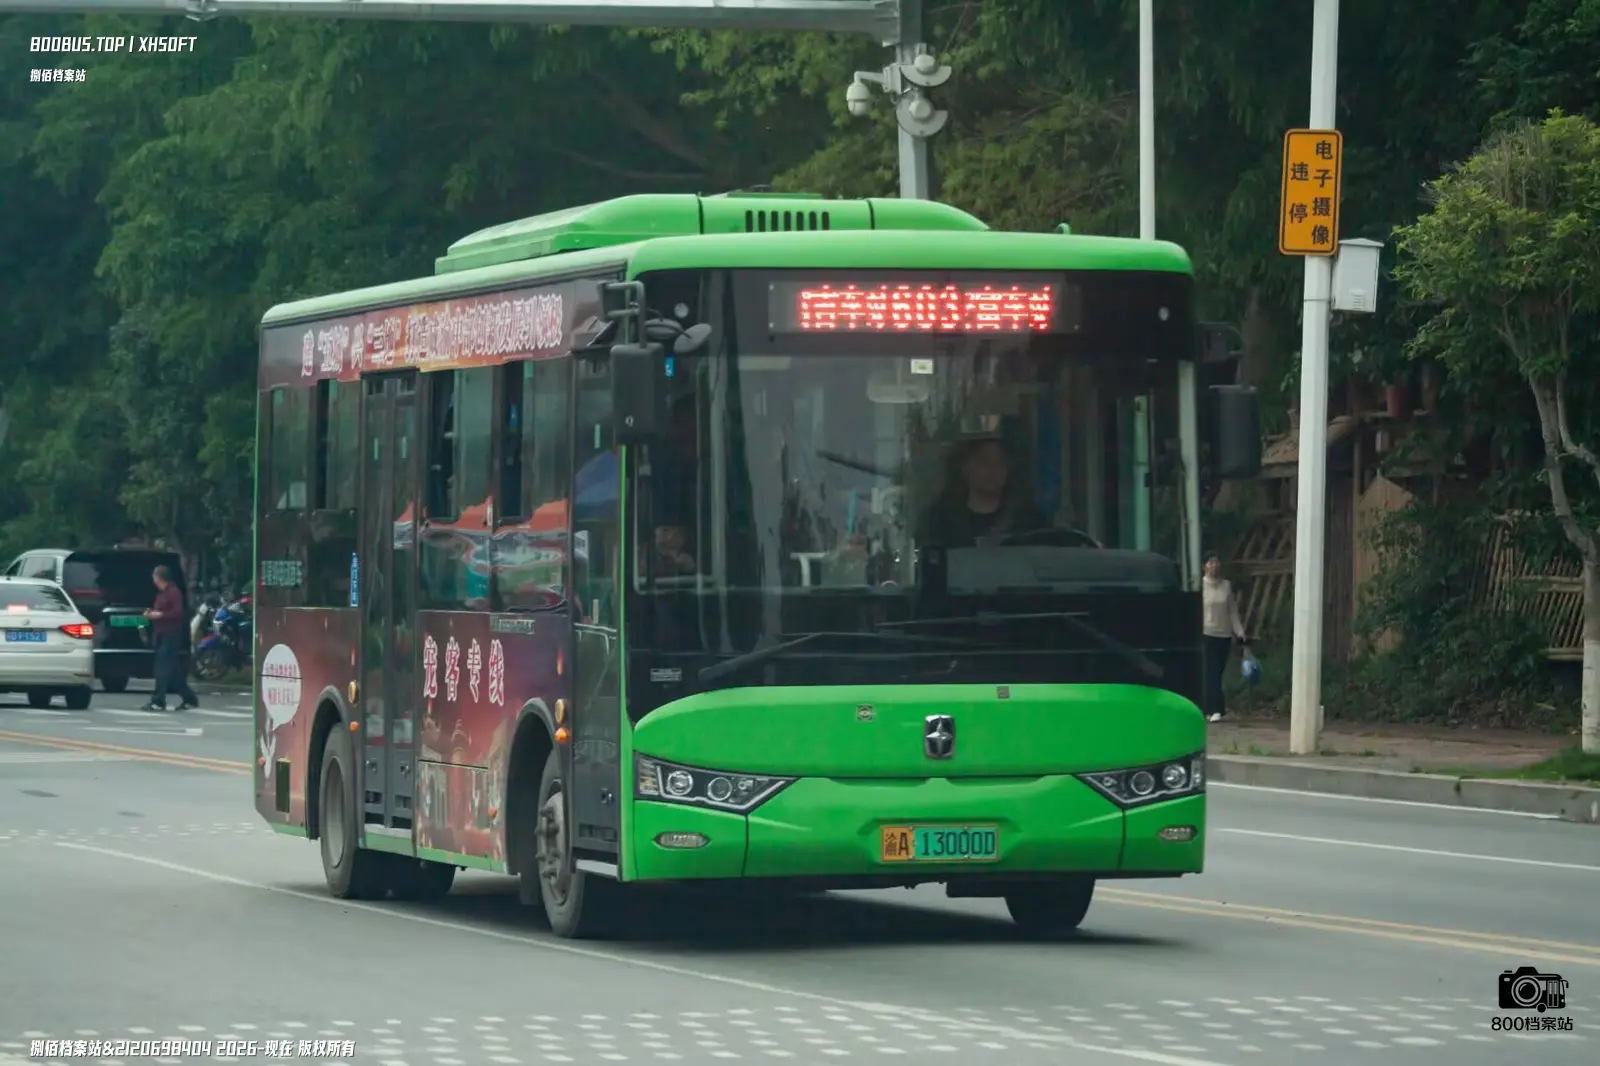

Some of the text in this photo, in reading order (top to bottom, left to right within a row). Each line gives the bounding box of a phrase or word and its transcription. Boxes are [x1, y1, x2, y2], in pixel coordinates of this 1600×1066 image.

[1288, 161, 1310, 225] 违停
[1311, 139, 1334, 246] 电子摄像
